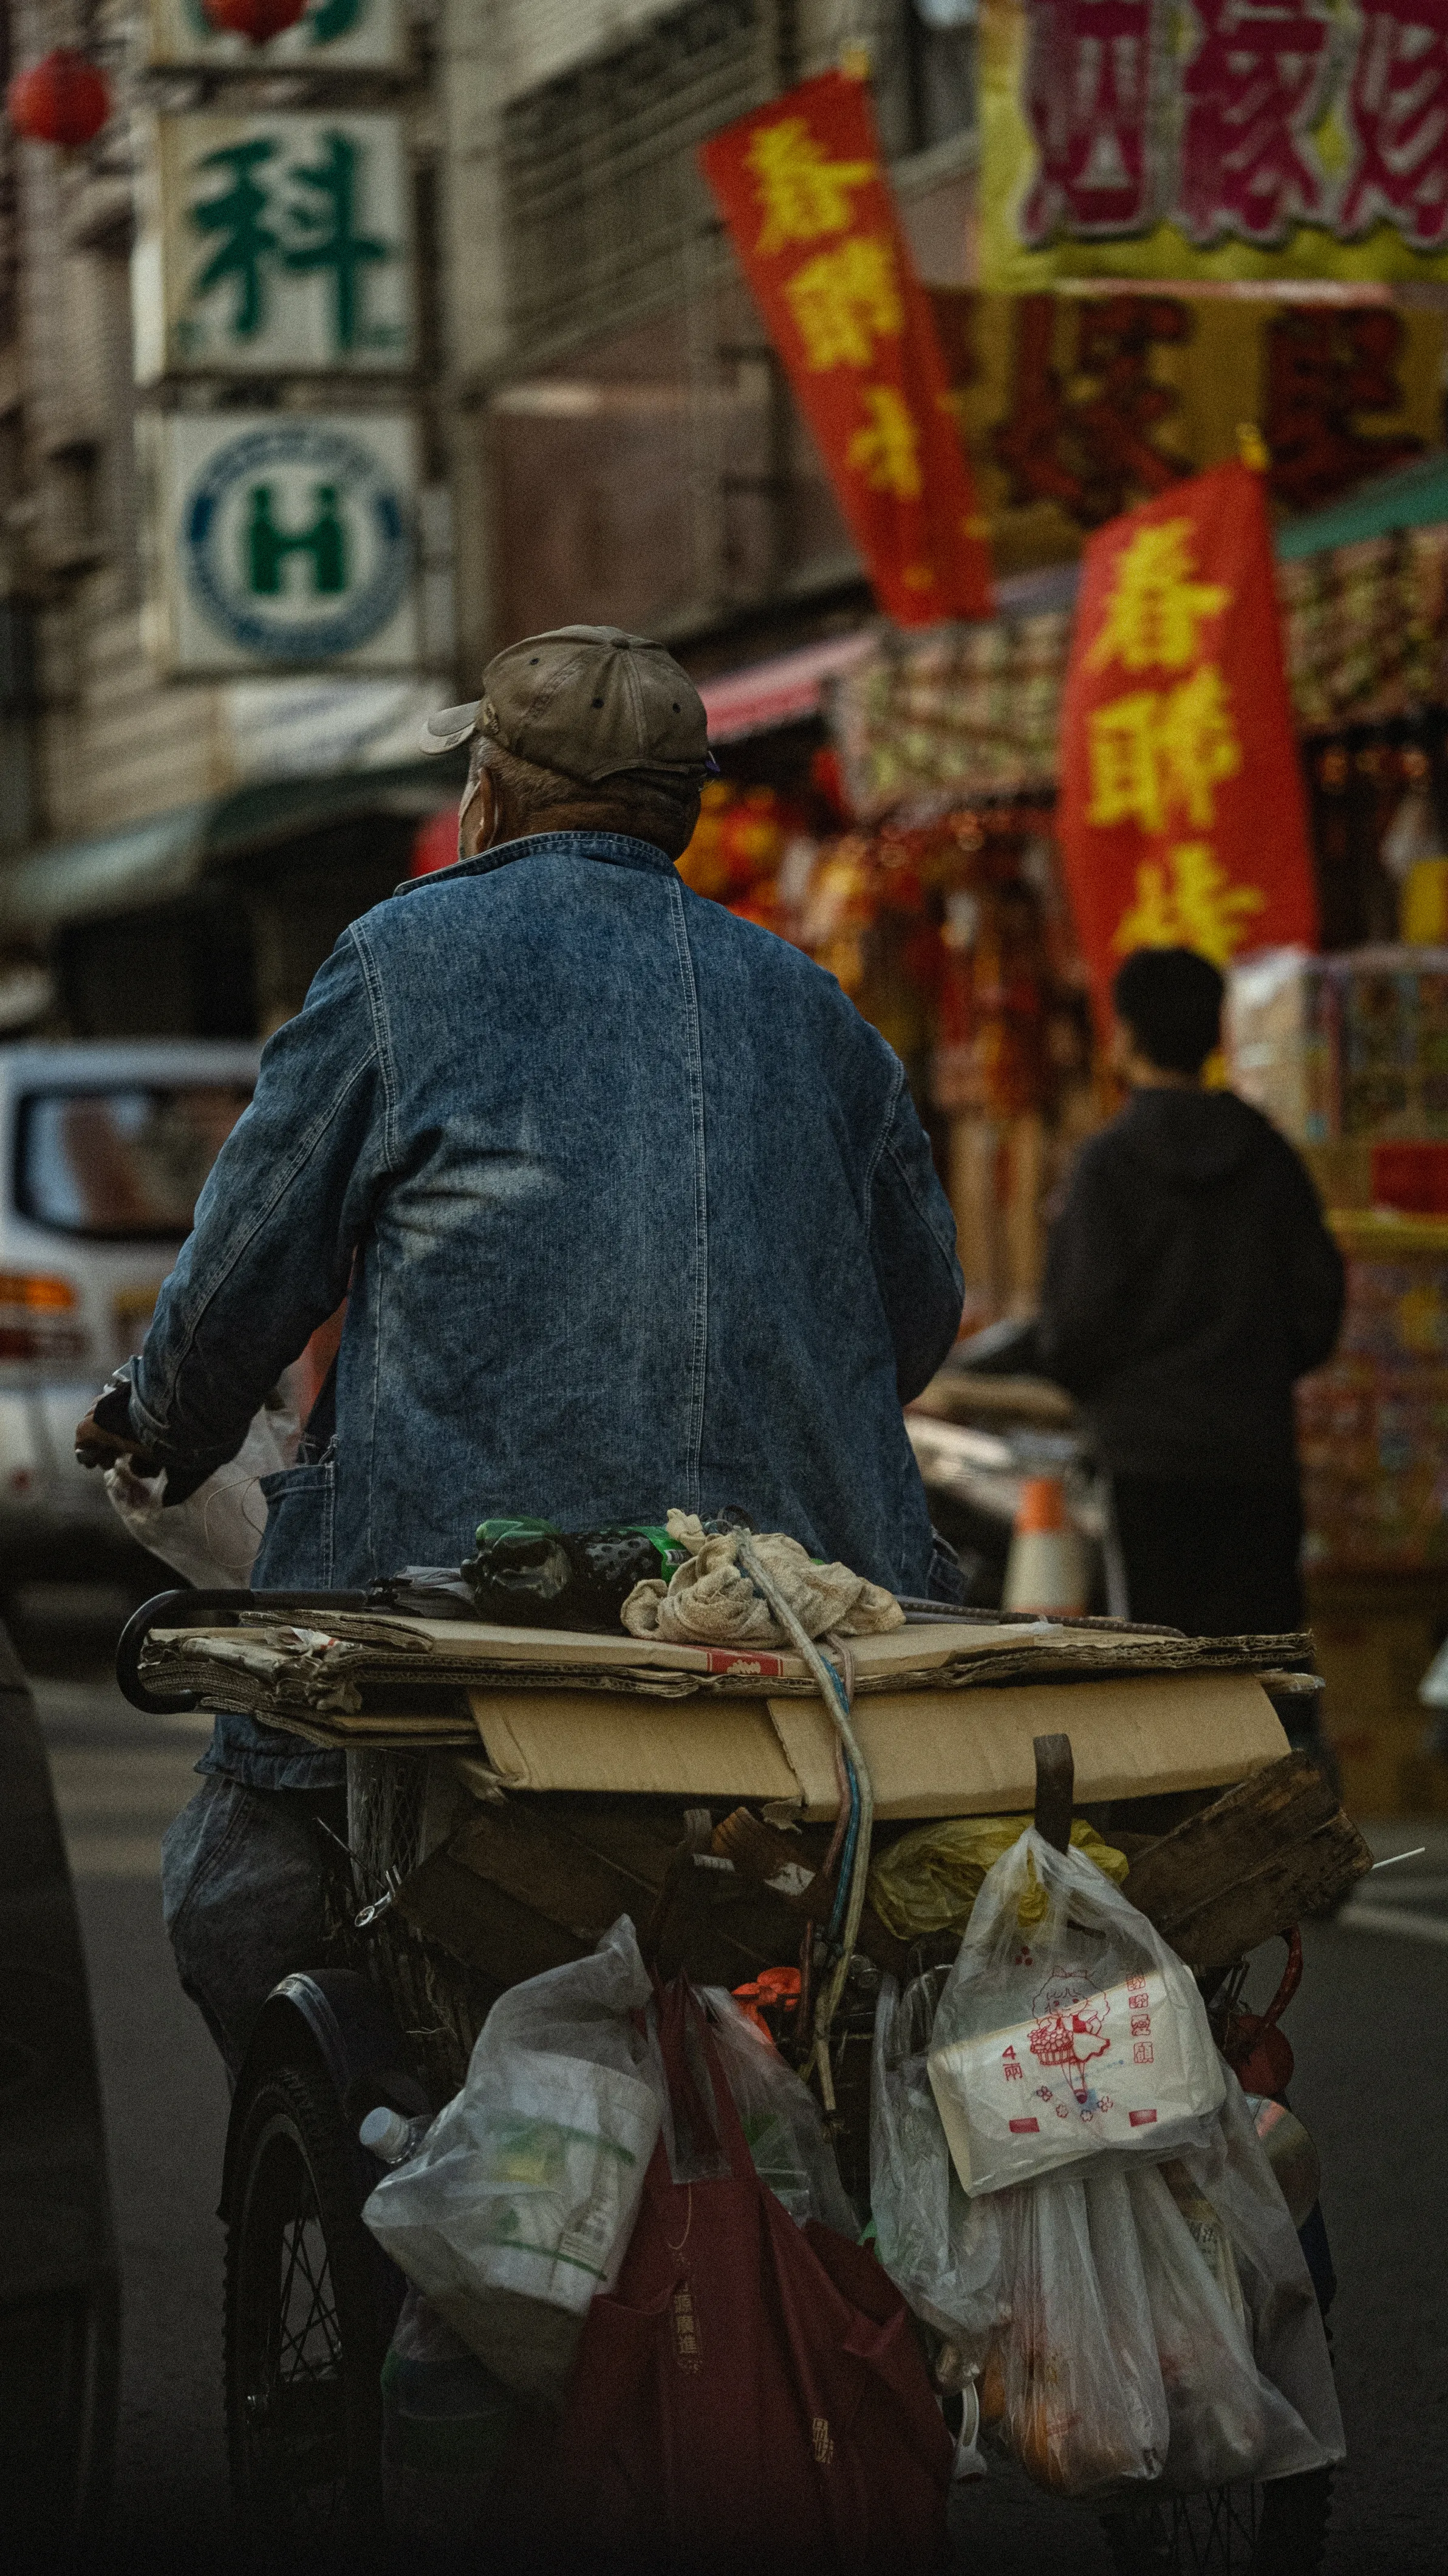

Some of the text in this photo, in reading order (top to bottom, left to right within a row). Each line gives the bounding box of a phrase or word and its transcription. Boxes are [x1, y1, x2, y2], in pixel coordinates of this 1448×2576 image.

[191, 129, 388, 349] 科
[1002, 2044, 1023, 2081] 4兩
[674, 2281, 698, 2354] 源廣進
